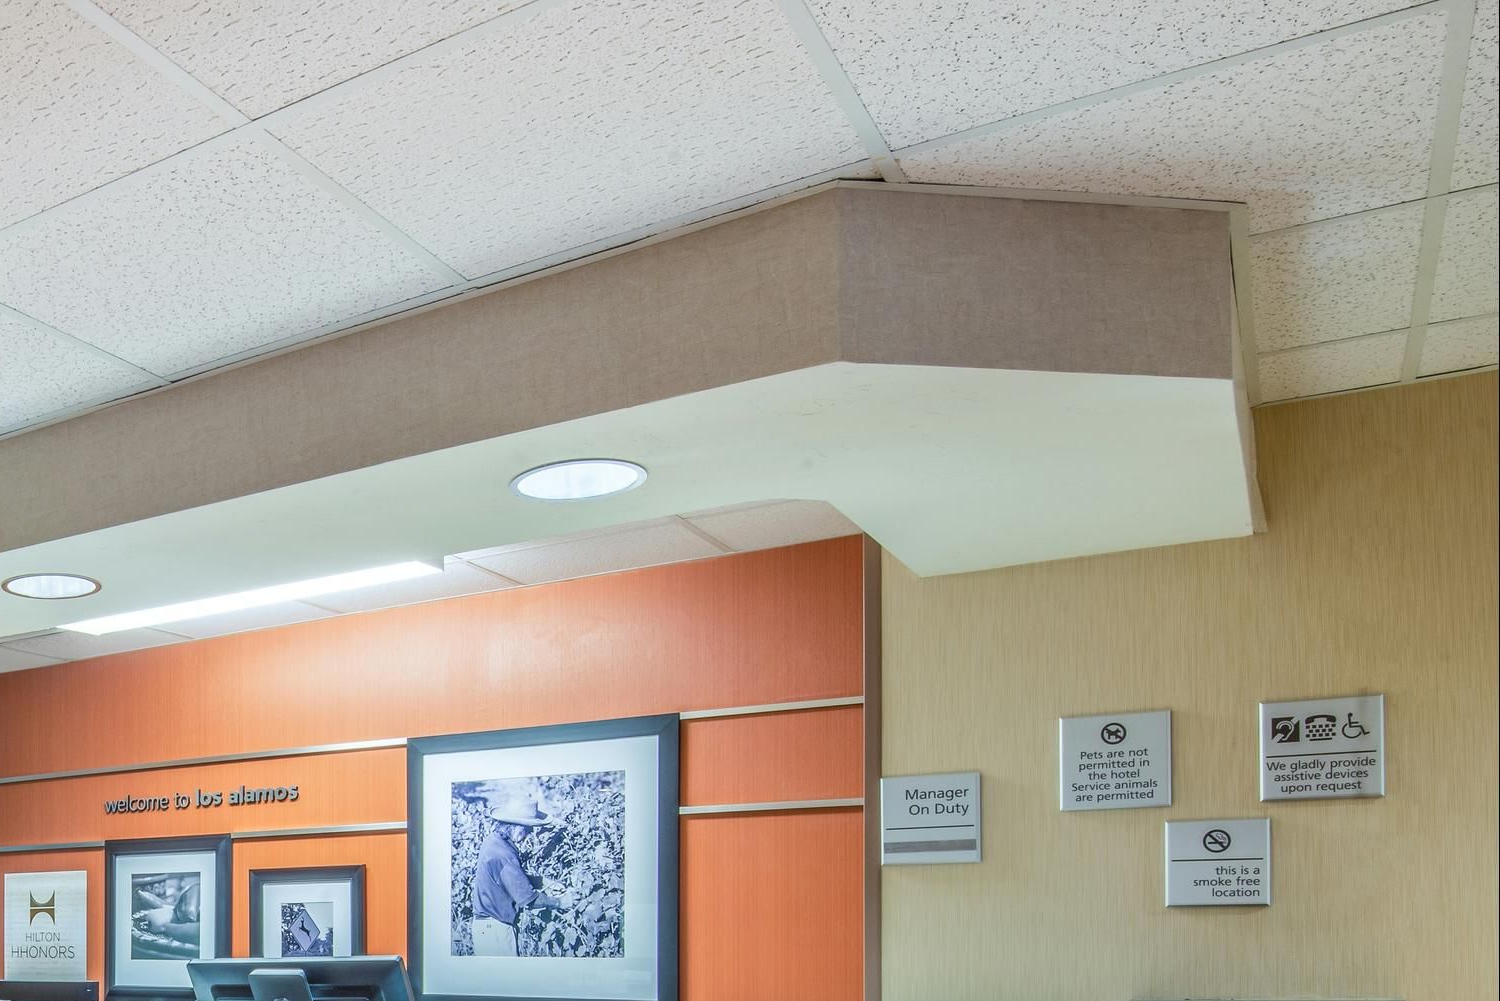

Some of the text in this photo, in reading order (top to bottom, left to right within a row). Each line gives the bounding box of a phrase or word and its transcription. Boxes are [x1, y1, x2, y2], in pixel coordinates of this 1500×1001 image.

[1080, 748, 1148, 760] Pets are not
[1078, 758, 1150, 772] permitted in
[1266, 756, 1376, 772] We gladly provide
[1088, 769, 1140, 780] the hotel
[1274, 769, 1369, 782] assistive devices
[1071, 779, 1158, 792] Service animals
[1280, 781, 1362, 794] upon request
[105, 784, 299, 815] welcome to los alamos
[905, 788, 969, 801] Manager
[1075, 789, 1154, 803] are permitted
[908, 803, 969, 816] On Duty
[1215, 865, 1260, 875] this is a
[1193, 876, 1261, 887] smoke free
[1211, 888, 1260, 897] location
[25, 932, 60, 942] HILTON
[11, 945, 76, 959] HHONORS
